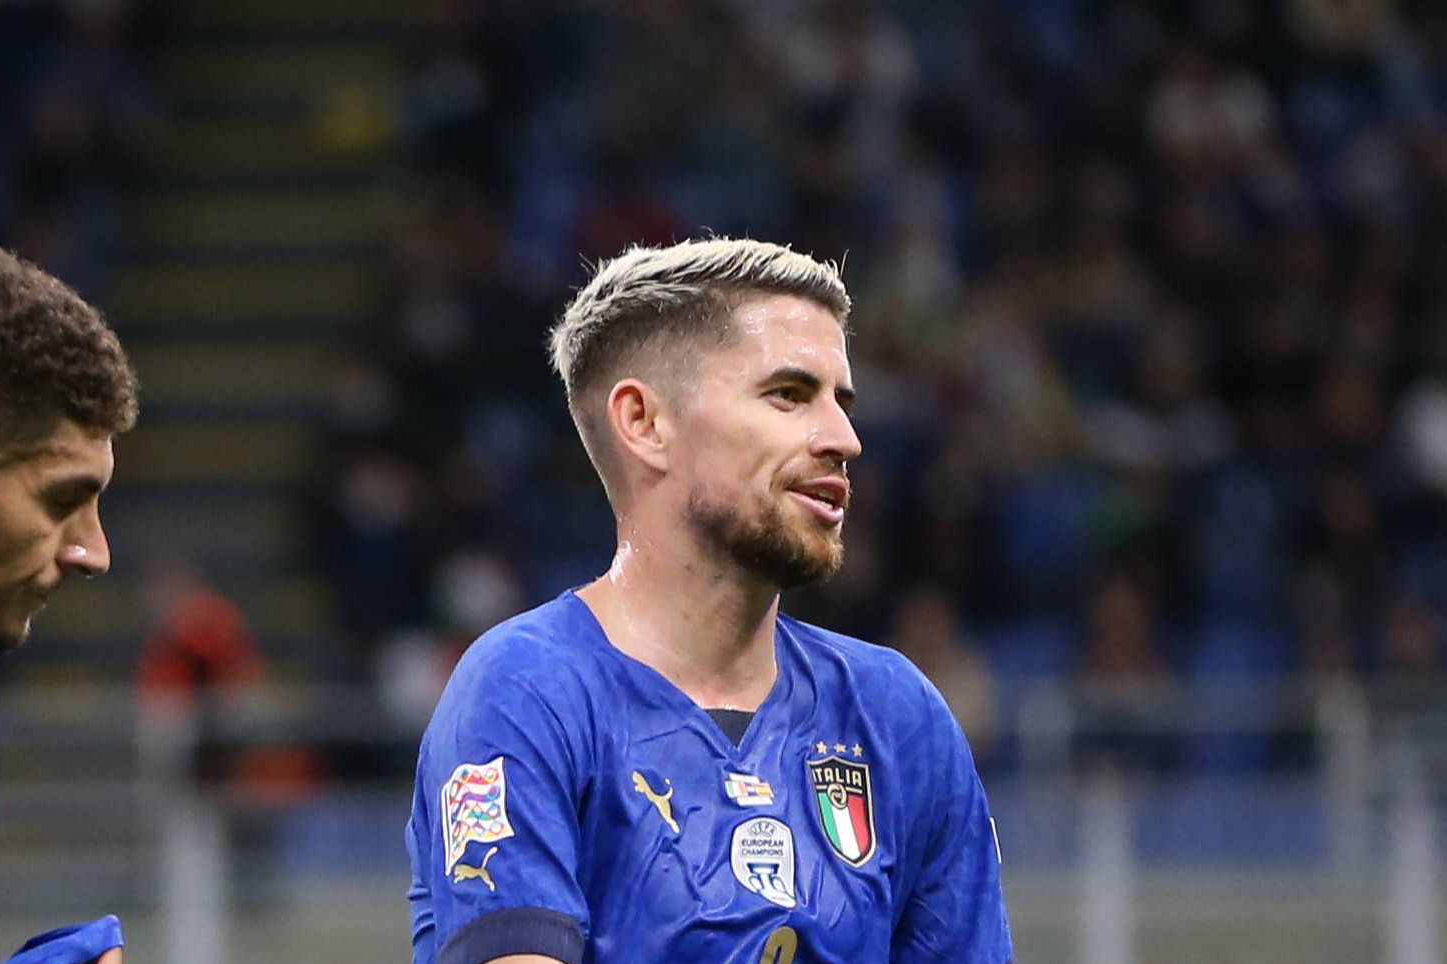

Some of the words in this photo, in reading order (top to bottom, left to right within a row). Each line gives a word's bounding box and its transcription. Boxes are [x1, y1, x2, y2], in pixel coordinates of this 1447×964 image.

[812, 767, 863, 787] ITALIA
[741, 838, 784, 848] EUROPEAN
[741, 848, 784, 857] CHAMPIONS
